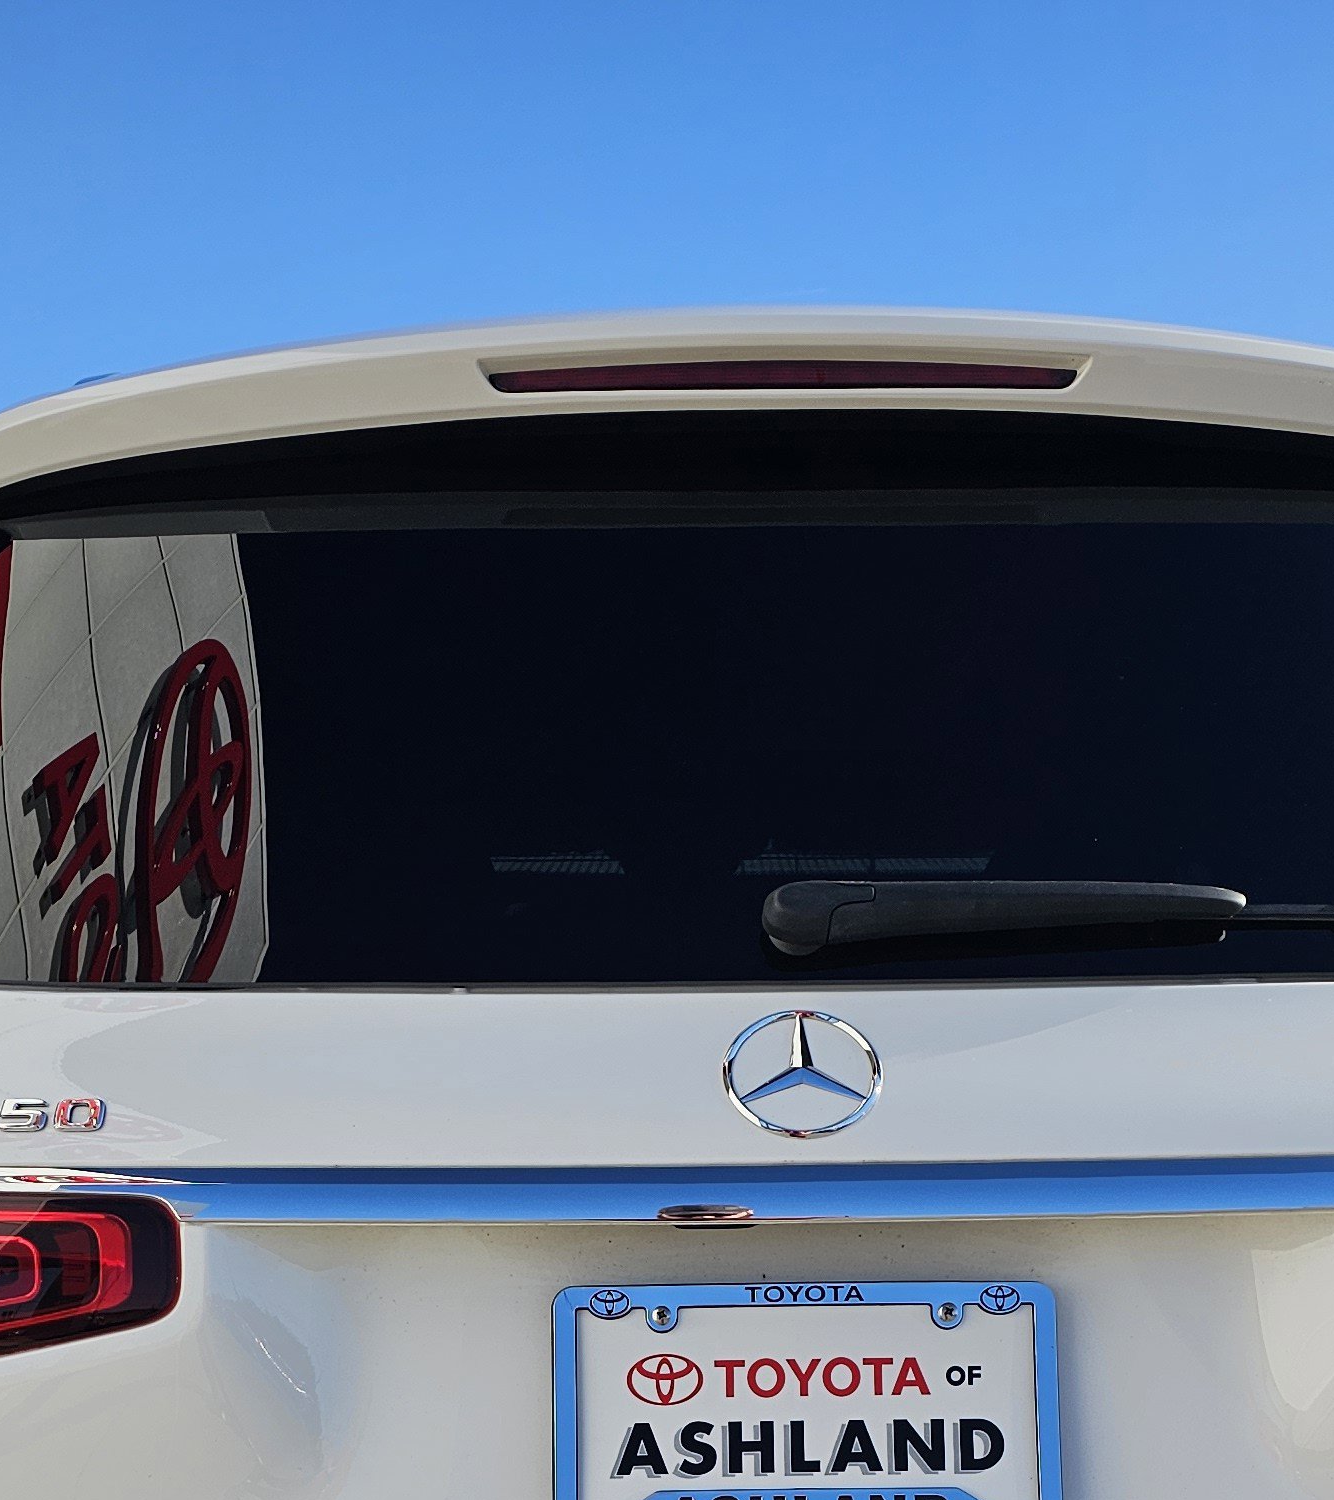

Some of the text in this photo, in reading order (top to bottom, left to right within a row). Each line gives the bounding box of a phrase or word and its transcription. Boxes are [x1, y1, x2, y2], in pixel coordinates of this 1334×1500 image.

[744, 1285, 865, 1303] TOYOTA
[714, 1357, 982, 1398] TOYOTA OF
[611, 1418, 1005, 1480] ASHLAND
